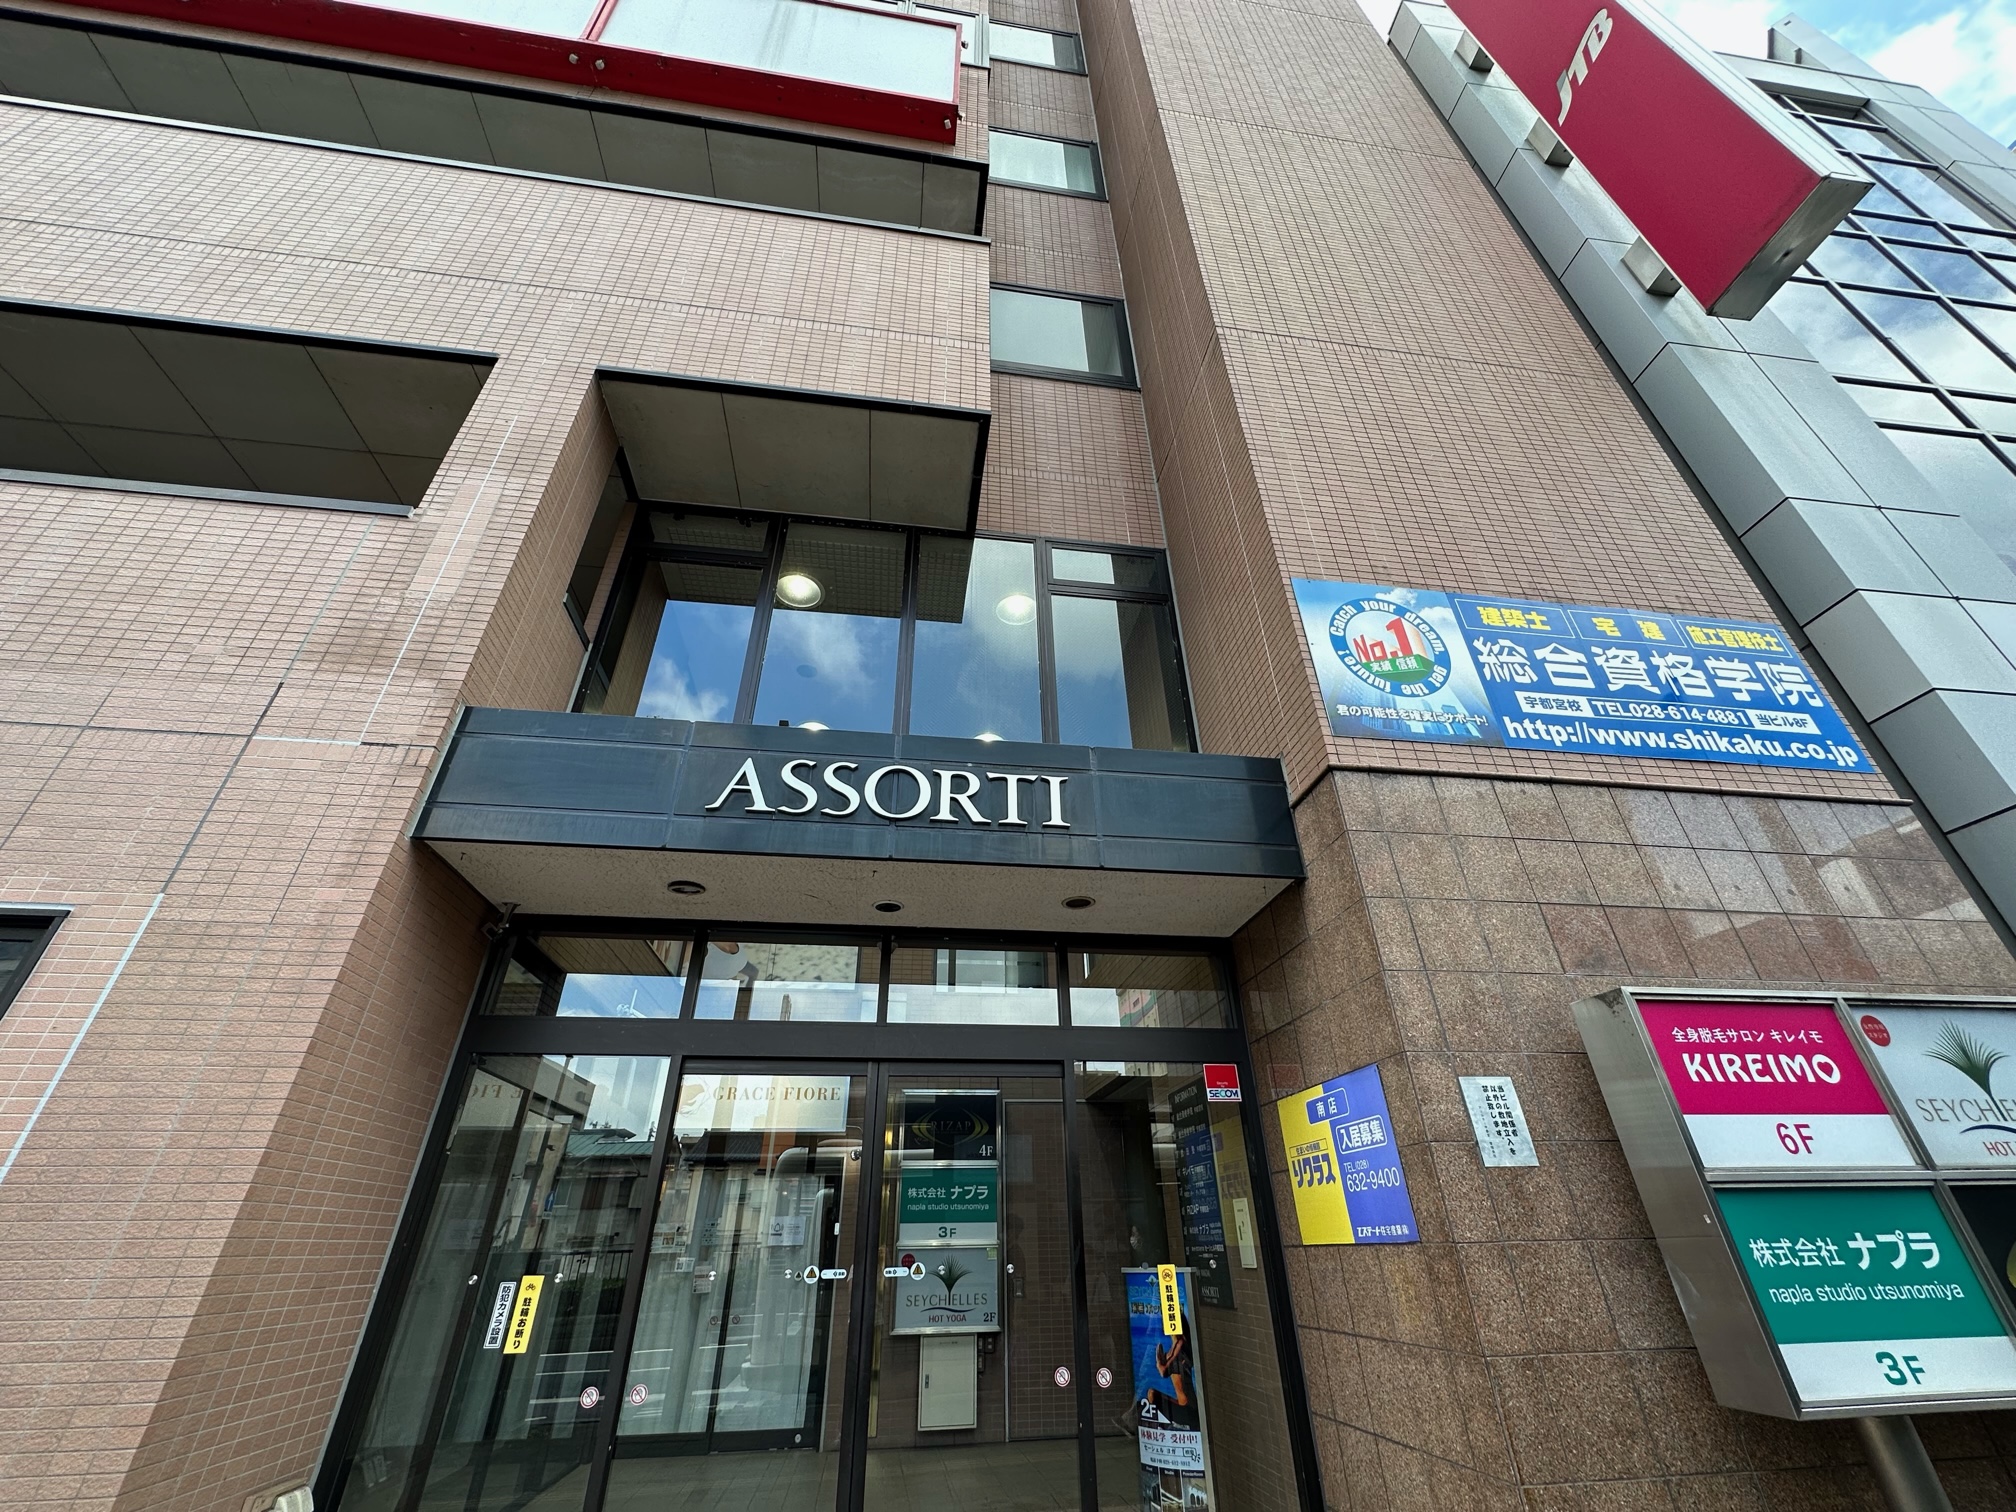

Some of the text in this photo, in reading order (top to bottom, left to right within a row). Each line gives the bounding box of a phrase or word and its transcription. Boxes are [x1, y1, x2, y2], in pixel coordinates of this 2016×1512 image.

[1556, 8, 1613, 127] JTB
[1330, 604, 1357, 637] Catch
[1360, 600, 1397, 614] your
[1476, 606, 1551, 631] 建築士
[1353, 616, 1414, 664] No.1
[1685, 625, 1785, 652] 施工管理技士
[1370, 656, 1419, 673] 実績 信頼
[1429, 664, 1448, 688] get
[1473, 636, 1825, 708] 総合資格学院
[1401, 682, 1430, 697] the
[1523, 695, 1584, 713] 宇都宮校
[1592, 700, 1749, 726] TEL028-614-4881
[1756, 712, 1809, 729] 当ビル8F
[1502, 716, 1859, 768] http://www.shikaku.co.jp
[704, 757, 1071, 829] ASSORTI
[1671, 1026, 1824, 1045] 全身脱毛サロン キレイモ
[1682, 1052, 1841, 1085] KIREIMO
[713, 1086, 841, 1101] GRACE FIORE
[1208, 1089, 1239, 1098] SECOM
[1315, 1096, 1338, 1118] 南店
[931, 1120, 972, 1131] RIZAP
[1339, 1118, 1385, 1150] 入居募集
[979, 1144, 994, 1157] 4F
[1775, 1123, 1815, 1155] 6F
[1983, 1141, 2016, 1157] HOT
[1292, 1153, 1337, 1189] リクラス
[1346, 1166, 1401, 1193] 632-9400
[907, 1185, 989, 1199] 株式会社 ナプラ
[907, 1203, 990, 1212] napla studio utsunomiya
[938, 1226, 957, 1239] 3F
[1749, 1229, 1941, 1271] 株式会社 ナプラ
[1768, 1281, 1965, 1305] napla studio utsunomiya
[488, 1285, 512, 1345] 防犯カメラ設置
[929, 1313, 967, 1322] HOT YOGA
[983, 1312, 997, 1322] 2F
[1165, 1285, 1177, 1332] 駐輪お断り
[513, 1297, 532, 1349] 駐輪お断り
[1875, 1350, 1926, 1386] 3F
[1140, 1398, 1157, 1418] 2F
[1141, 1429, 1166, 1443] 体験見学
